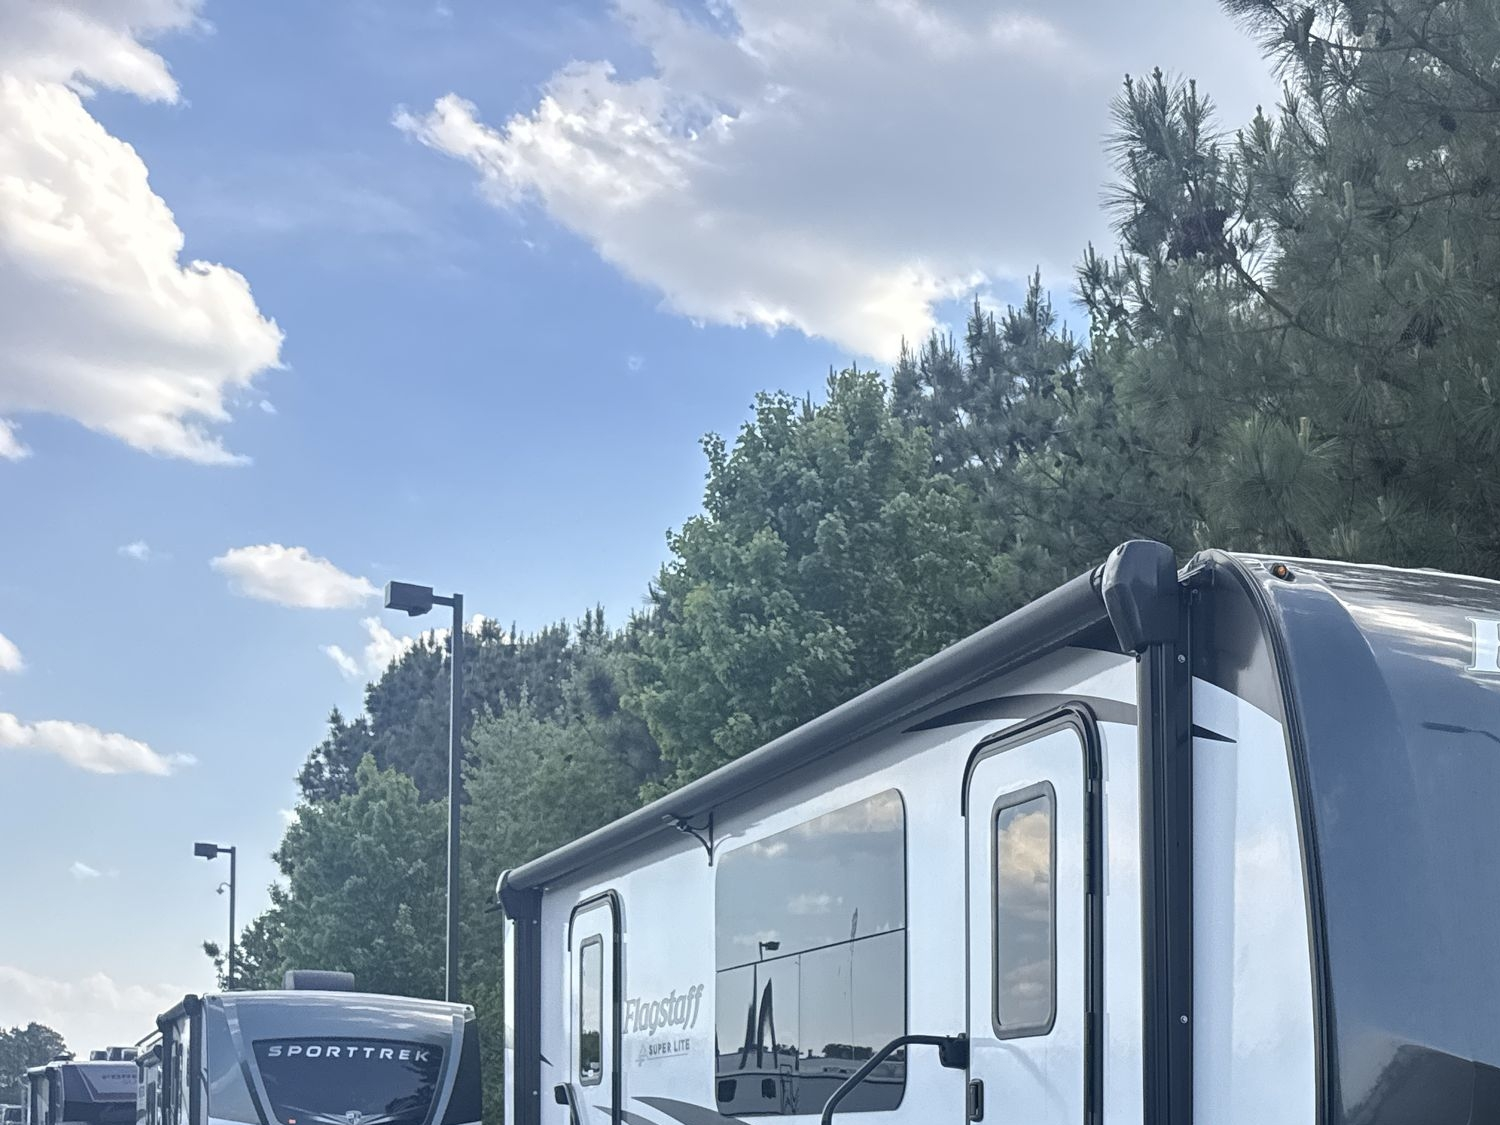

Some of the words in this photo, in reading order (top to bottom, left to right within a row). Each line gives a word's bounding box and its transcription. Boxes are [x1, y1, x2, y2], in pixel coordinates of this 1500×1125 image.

[620, 984, 704, 1036] Flagstaff
[268, 1045, 430, 1062] SPORTTREK
[649, 1041, 672, 1055] SUPER
[674, 1039, 690, 1052] LITE
